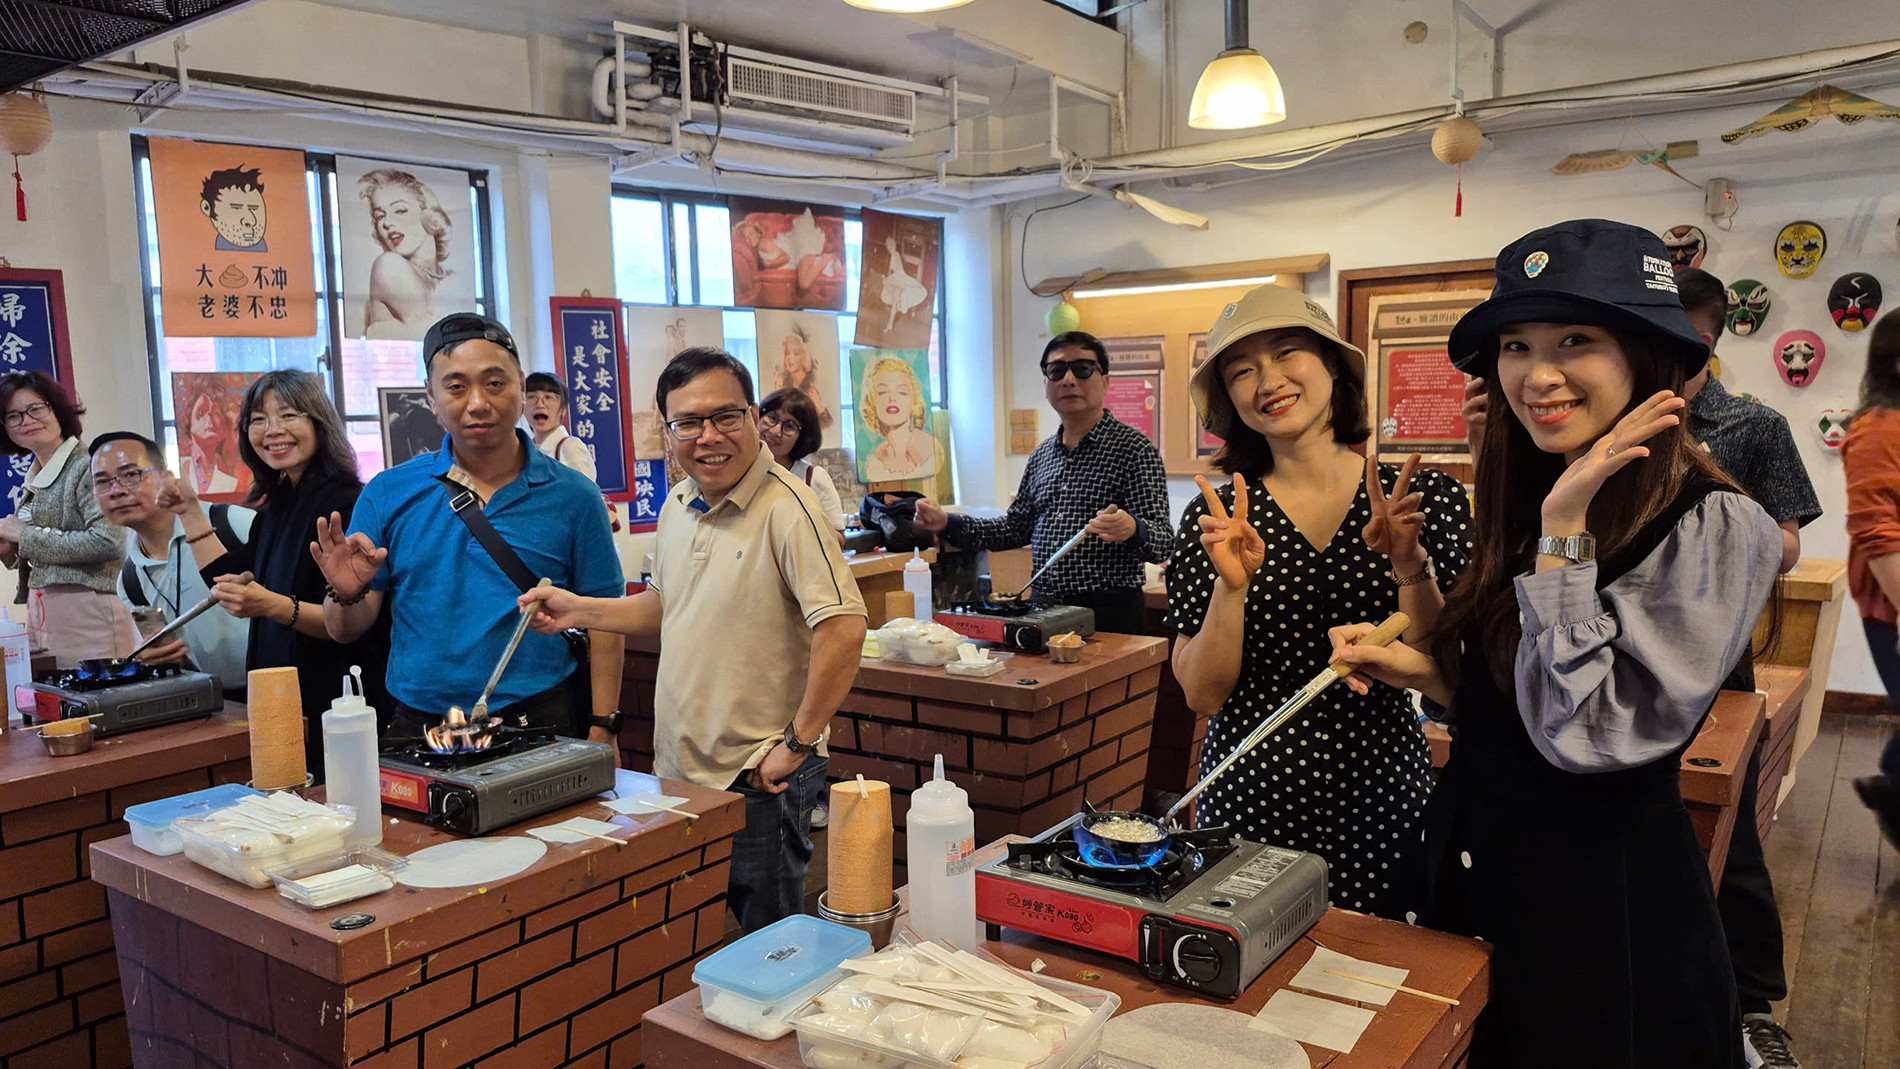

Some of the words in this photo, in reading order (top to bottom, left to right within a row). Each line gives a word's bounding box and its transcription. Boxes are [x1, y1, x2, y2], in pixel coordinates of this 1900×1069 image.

[196, 263, 214, 288] 大
[198, 294, 288, 320] 老婆不忠
[588, 319, 615, 412] 社會安全
[1057, 909, 1079, 921] K080
